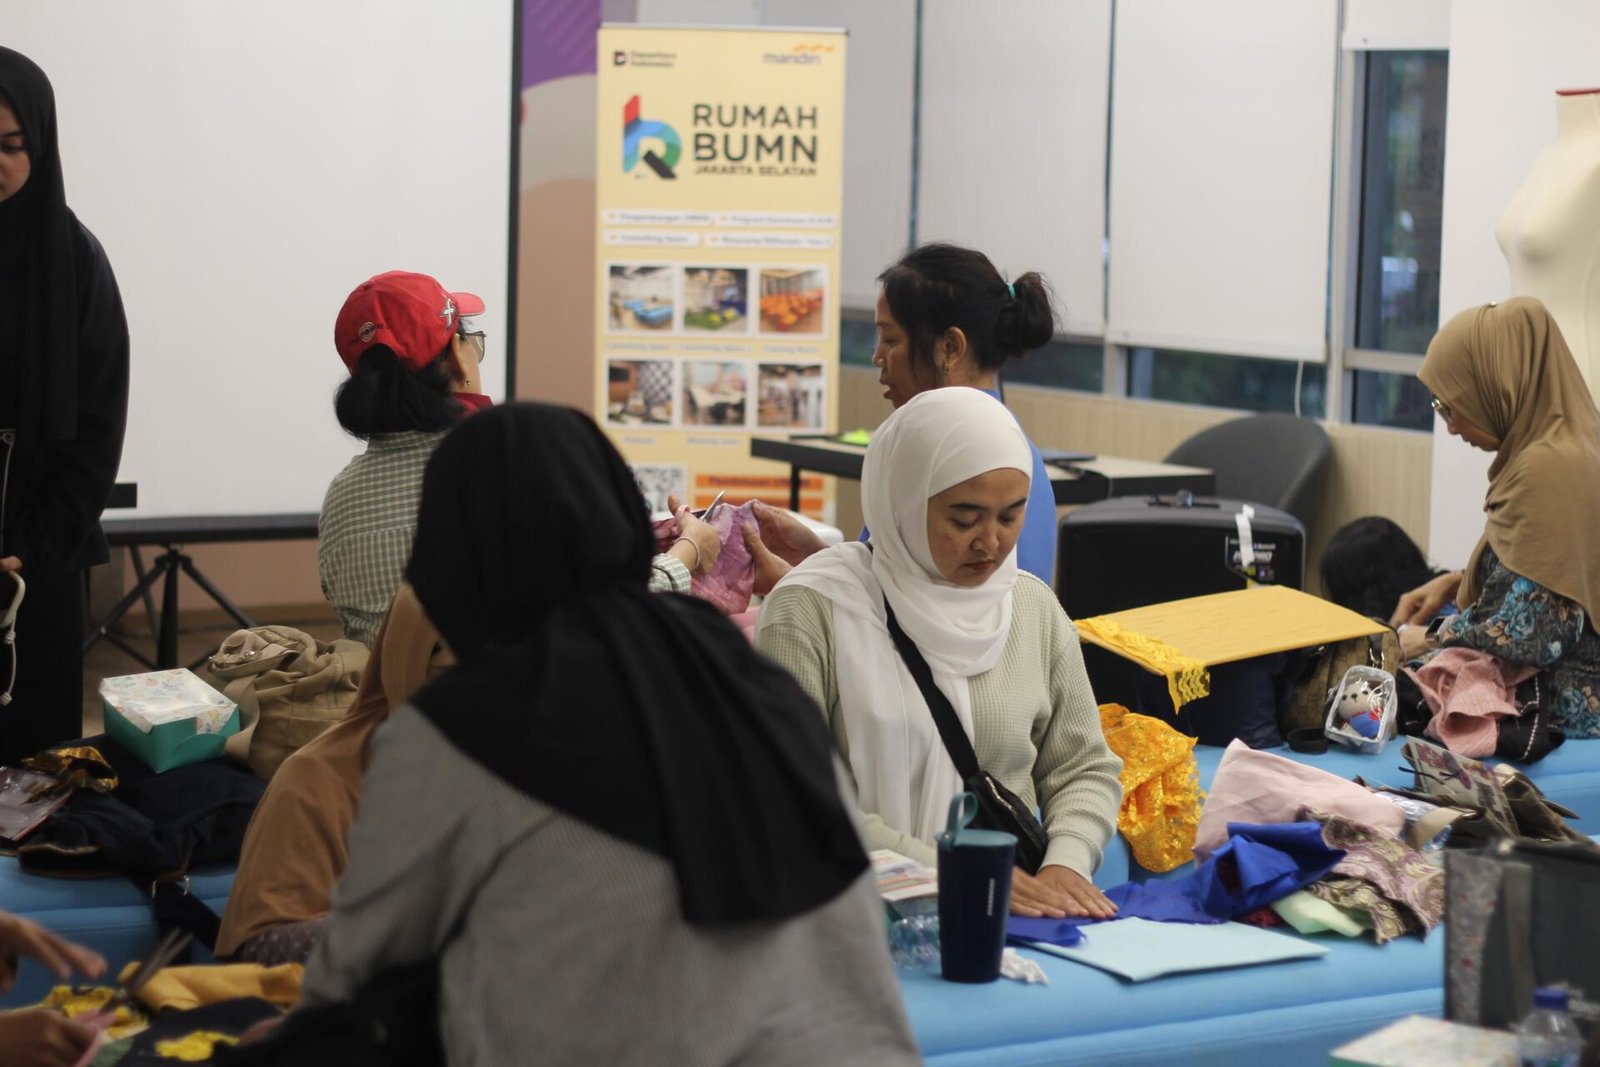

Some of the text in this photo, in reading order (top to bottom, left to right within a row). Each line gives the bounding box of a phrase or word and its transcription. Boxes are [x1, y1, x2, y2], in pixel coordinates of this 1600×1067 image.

[693, 103, 818, 129] RUMAH
[693, 132, 818, 163] BUMN
[694, 164, 818, 178] JAKARTA SELATAN
